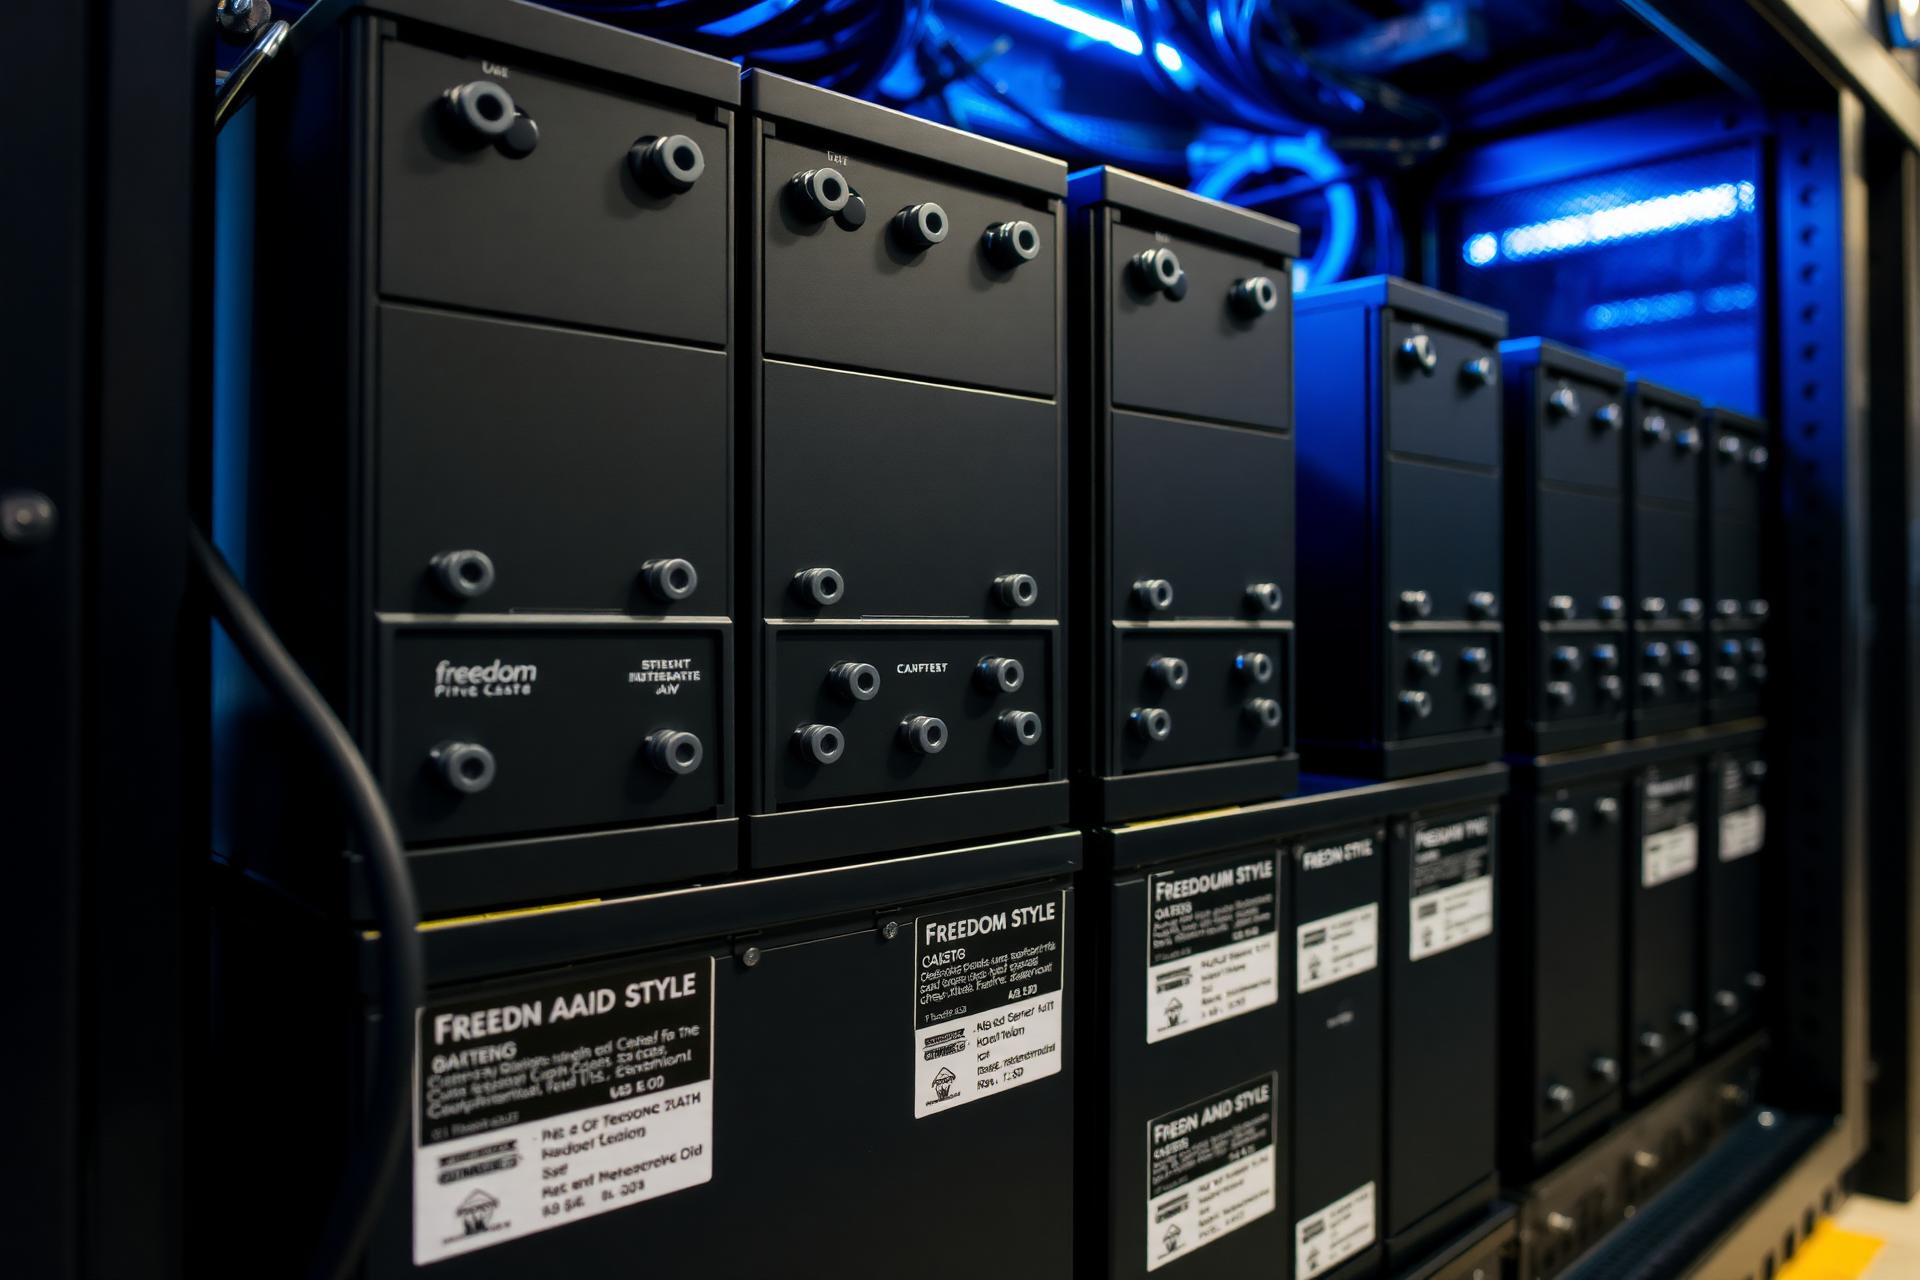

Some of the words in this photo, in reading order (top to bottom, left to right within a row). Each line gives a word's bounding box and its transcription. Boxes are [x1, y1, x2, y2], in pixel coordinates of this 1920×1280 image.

[435, 659, 537, 685] freedom
[1235, 860, 1273, 885] STYLE
[926, 911, 1007, 946] FREEDOM
[1011, 902, 1056, 928] STYLE
[434, 1001, 542, 1046] FREEDN
[625, 972, 697, 1008] STYLE
[1234, 1084, 1270, 1113] STYLE
